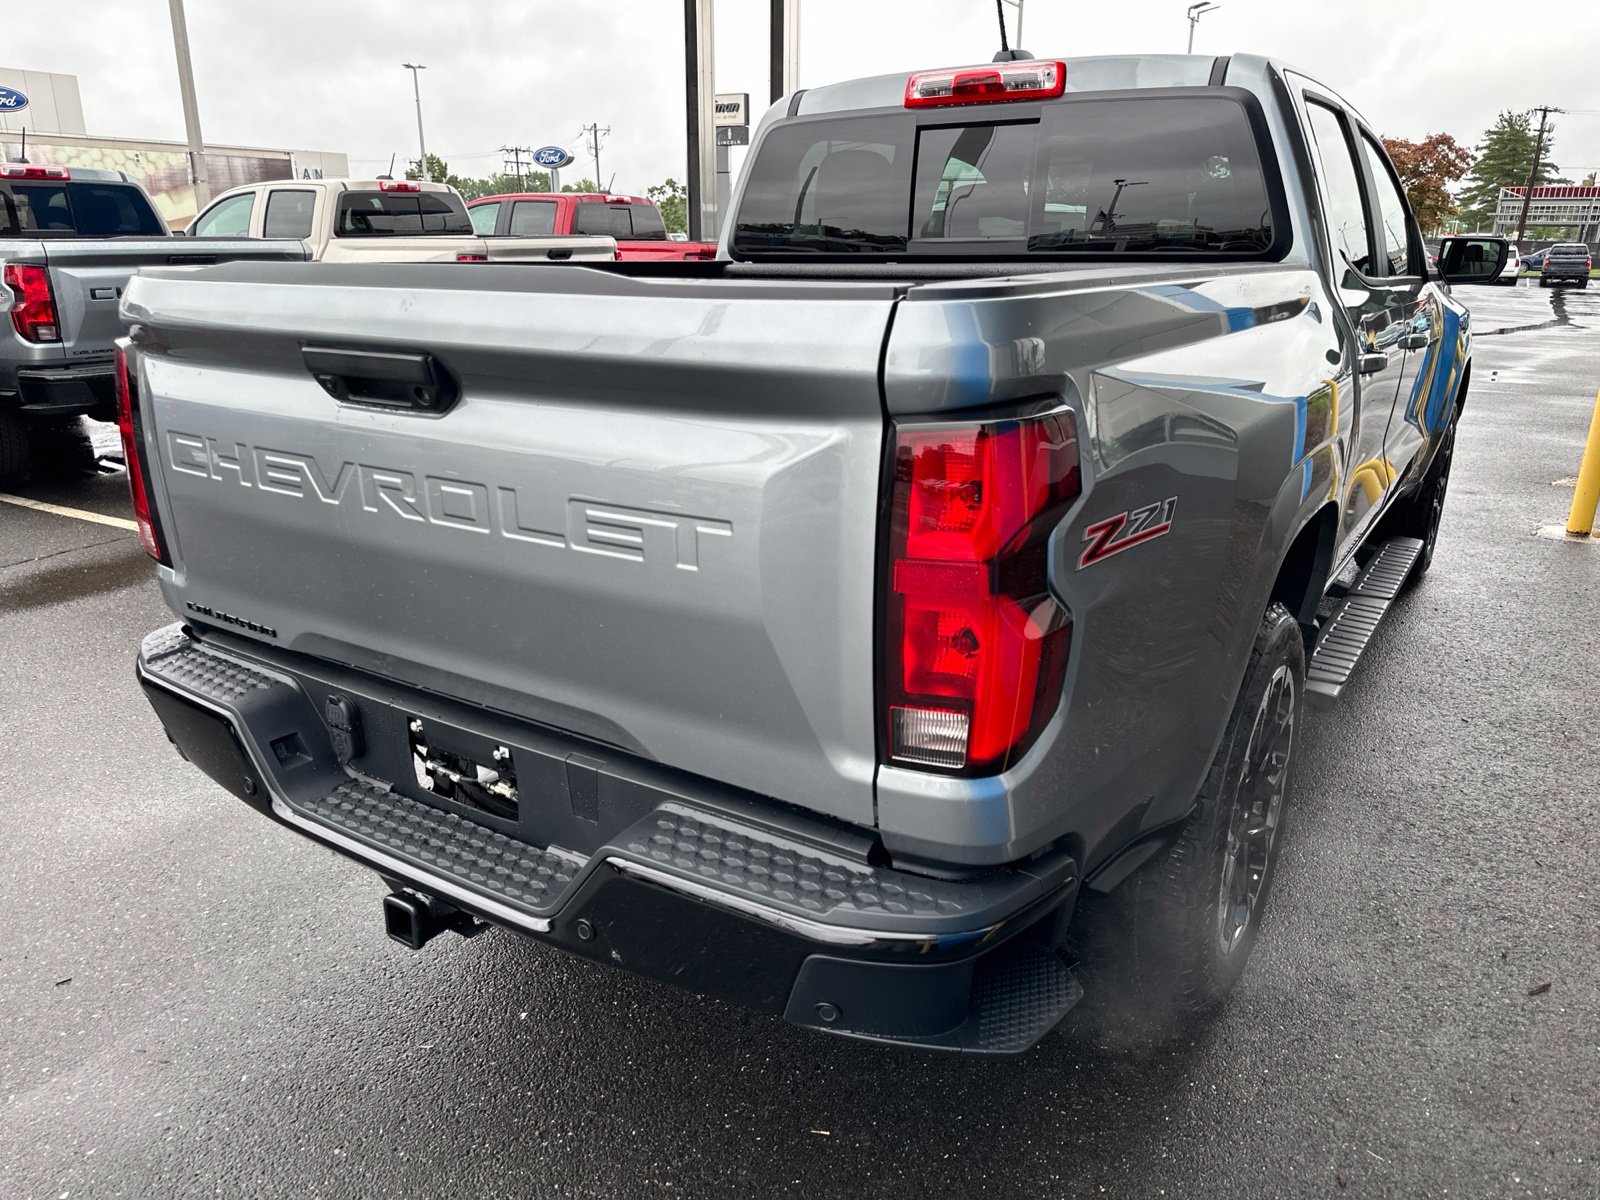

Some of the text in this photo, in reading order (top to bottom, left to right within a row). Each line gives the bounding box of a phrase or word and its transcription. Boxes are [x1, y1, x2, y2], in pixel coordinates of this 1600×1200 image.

[296, 167, 323, 180] AN
[539, 150, 561, 163] Ford
[167, 430, 733, 572] CHEVROLET
[1076, 495, 1179, 572] Z71
